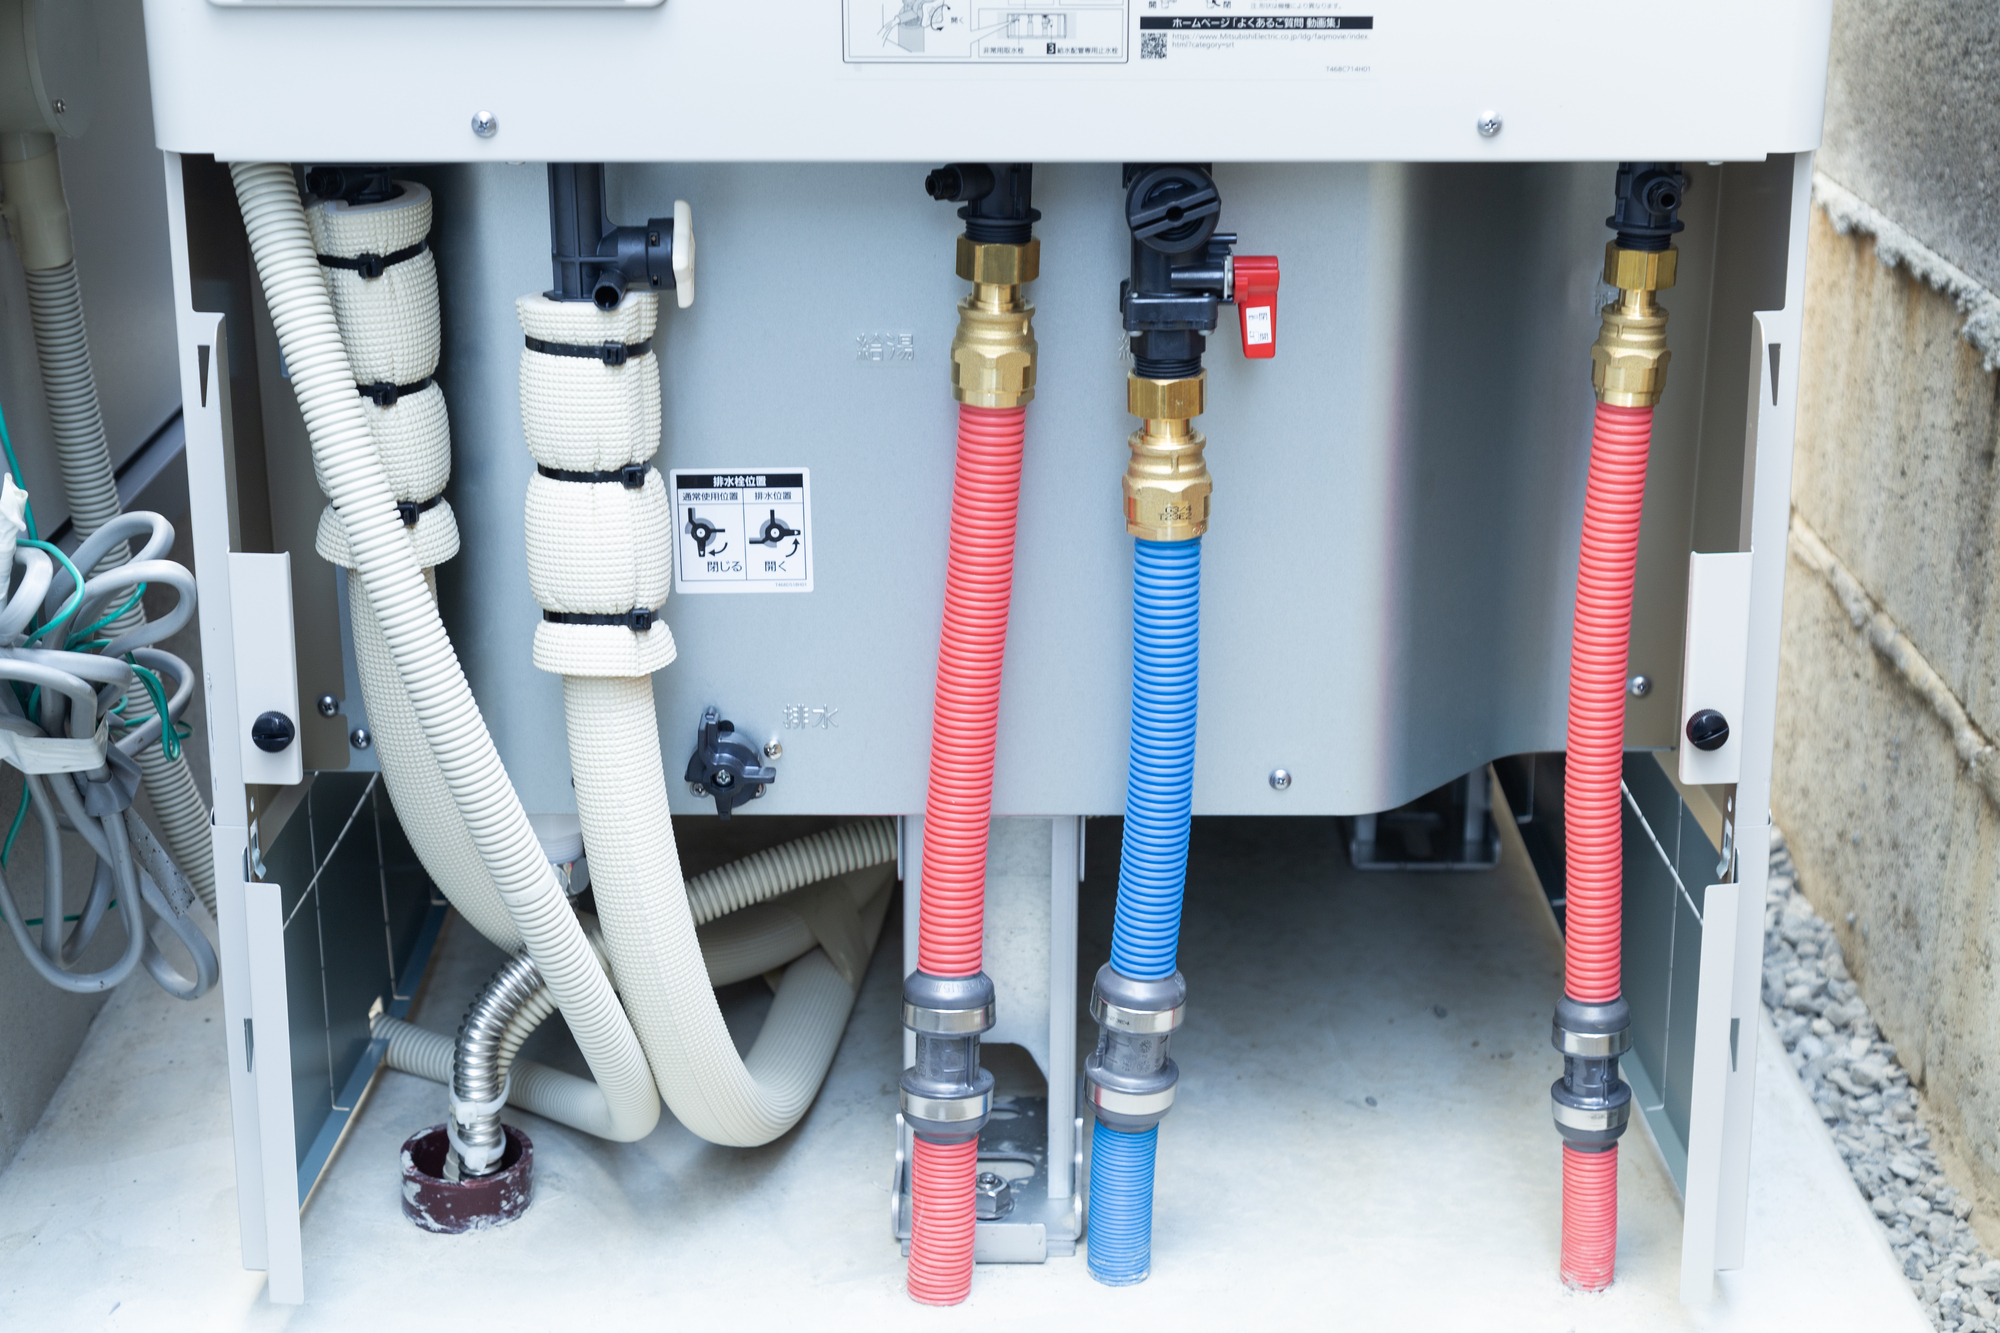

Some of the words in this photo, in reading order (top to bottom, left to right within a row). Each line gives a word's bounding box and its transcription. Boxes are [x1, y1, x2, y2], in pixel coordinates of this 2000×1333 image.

[983, 46, 1025, 55] 非常用取水栓
[1172, 42, 1235, 50] html?category=srt
[856, 332, 914, 361] 給湯
[713, 475, 767, 488] 排水栓位置
[682, 492, 739, 502] 通常使用位置
[754, 491, 792, 501] 排水位置
[707, 560, 742, 573] 閉じる
[764, 560, 787, 573] 開く
[783, 703, 840, 729] 排水
